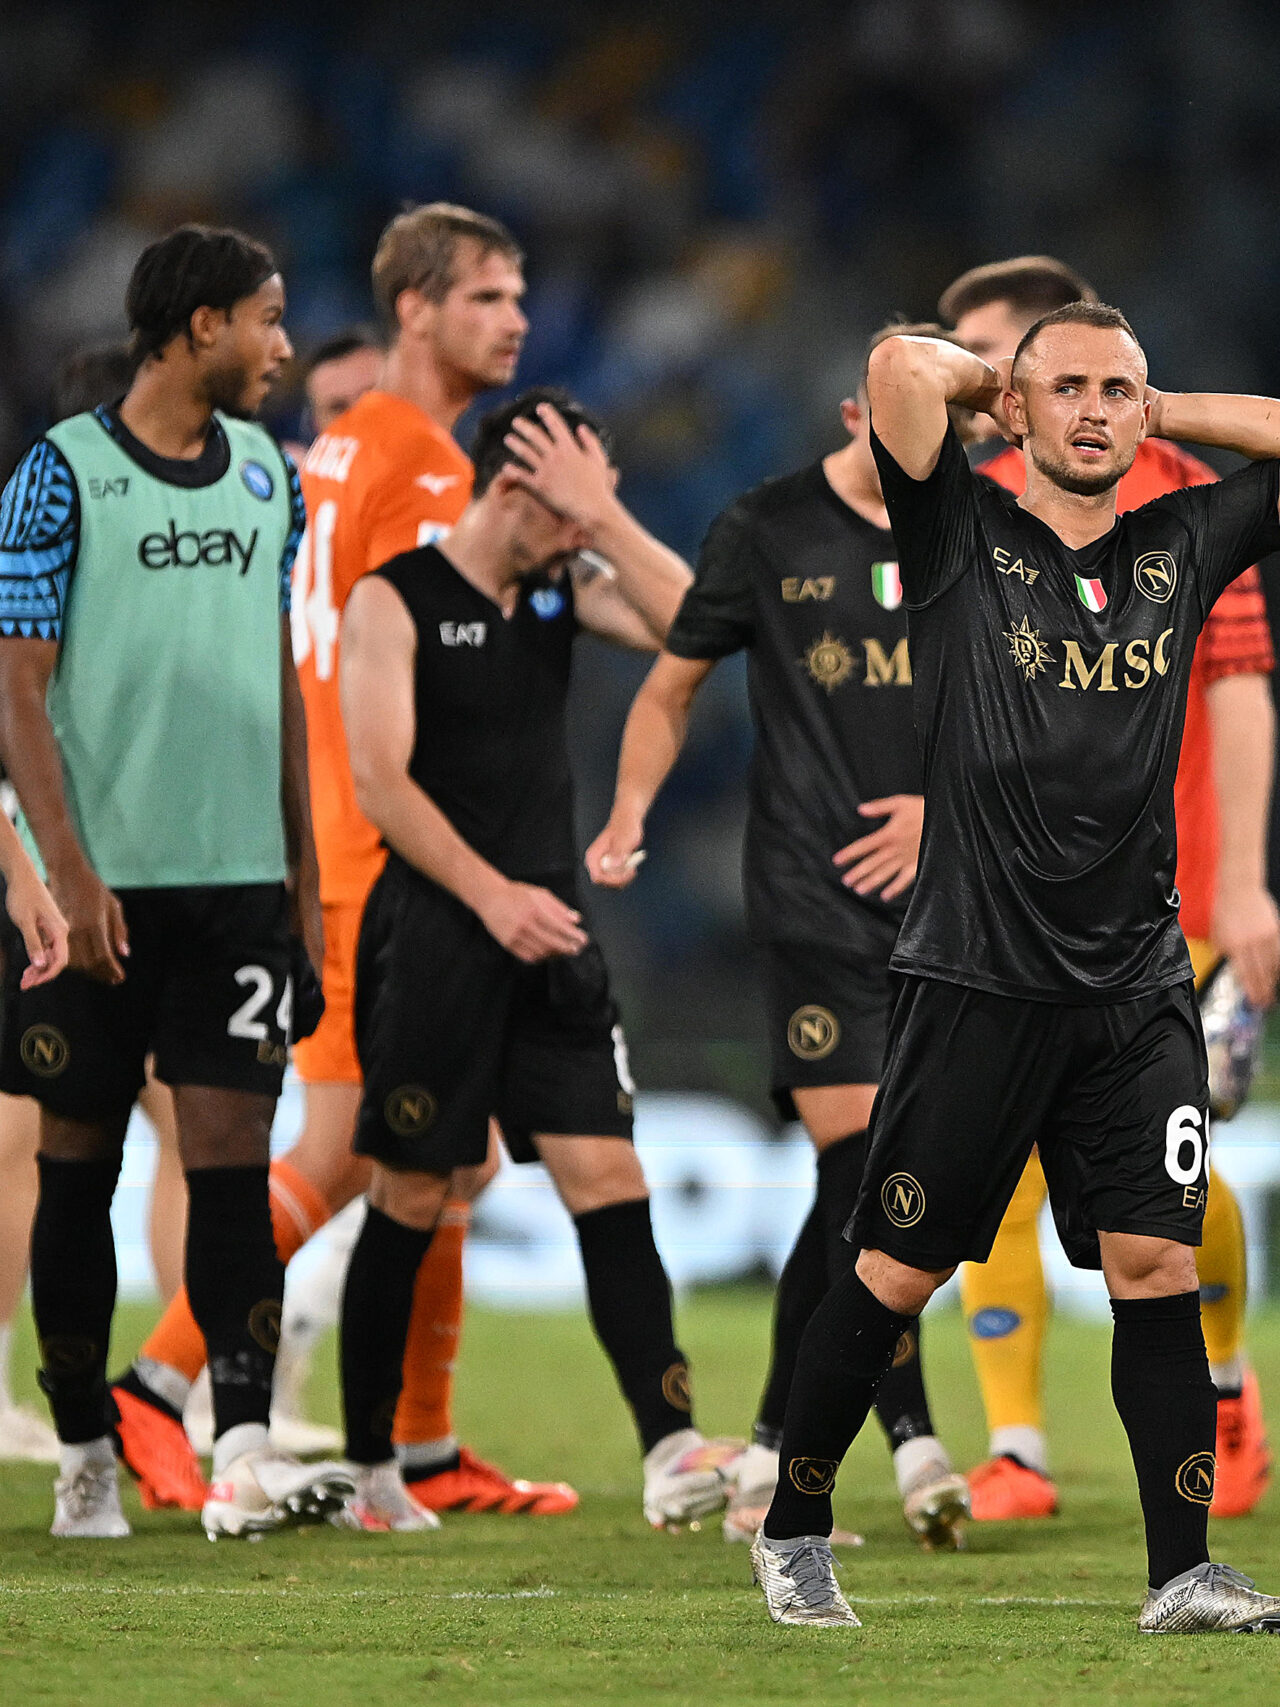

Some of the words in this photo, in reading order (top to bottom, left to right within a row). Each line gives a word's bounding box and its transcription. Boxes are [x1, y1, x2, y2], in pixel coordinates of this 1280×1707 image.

[88, 477, 130, 499] EA7
[137, 517, 259, 576] ebay
[993, 546, 1040, 586] EA7
[781, 575, 836, 602] EA7
[439, 621, 487, 648] EA7
[1182, 1185, 1208, 1211] EA
